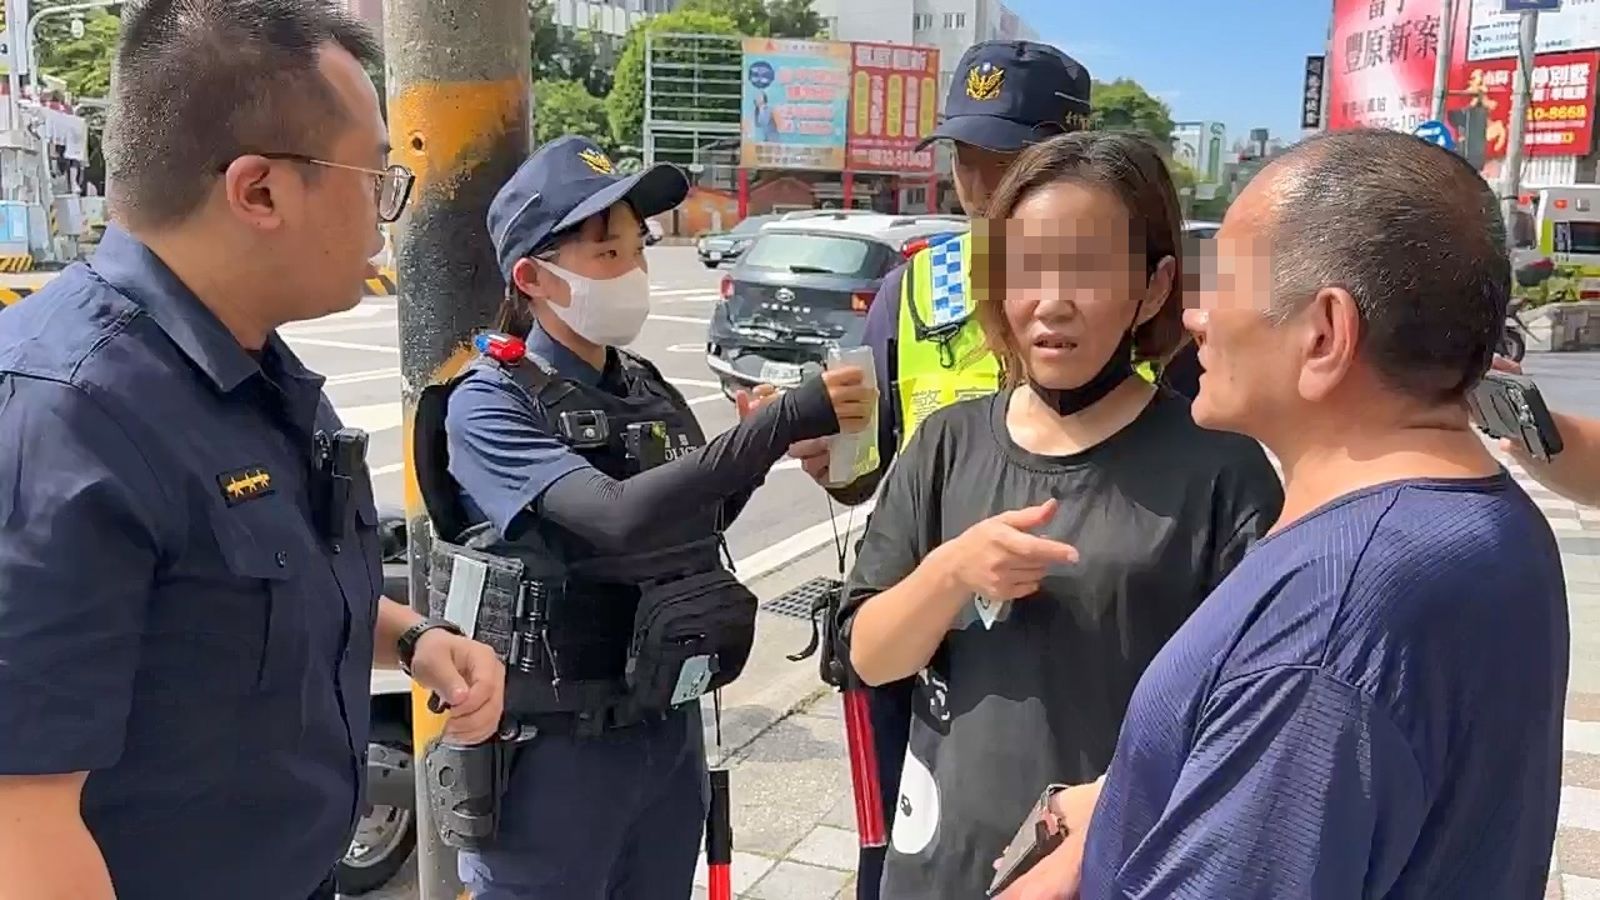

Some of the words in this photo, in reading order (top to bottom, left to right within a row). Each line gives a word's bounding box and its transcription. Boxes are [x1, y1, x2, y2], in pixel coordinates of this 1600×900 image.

[1343, 15, 1440, 74] 豐原新案
[664, 445, 697, 461] OLIC
